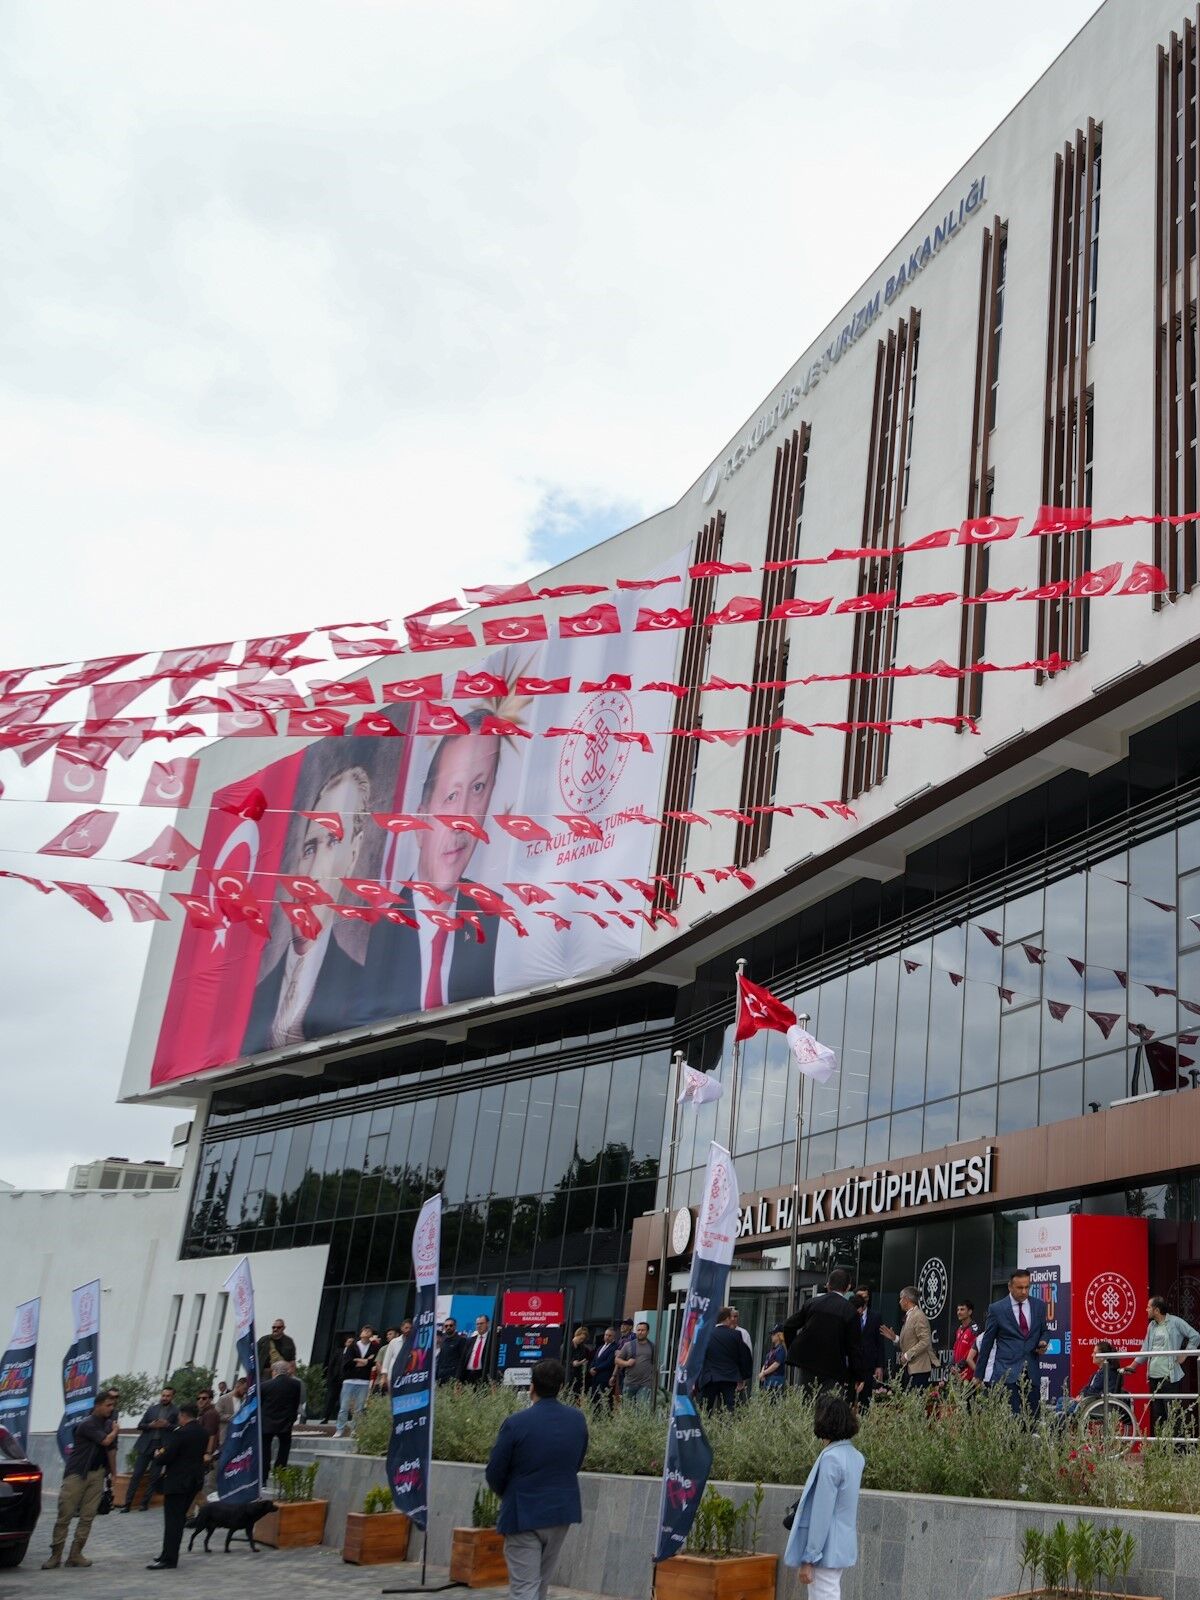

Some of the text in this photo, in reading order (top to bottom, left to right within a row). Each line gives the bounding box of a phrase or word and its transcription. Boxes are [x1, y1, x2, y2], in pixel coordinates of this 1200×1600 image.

[747, 385, 801, 457] KÜLTÜR
[800, 361, 821, 396] VE
[819, 289, 883, 374] TURİZM
[884, 174, 988, 306] BAKANLIĞI
[526, 841, 543, 858] T.C.
[545, 830, 587, 852] KÜLTÜ
[556, 834, 616, 866] BAKANLIĞI
[756, 1196, 772, 1234] İL
[775, 1188, 826, 1230] HALK
[830, 1146, 995, 1221] KÜTÜPHANESİ
[1029, 1269, 1058, 1282] TÜRKİYE
[1078, 1338, 1089, 1346] T.C.
[1113, 1338, 1121, 1346] VE
[675, 1428, 702, 1441] ayıs
